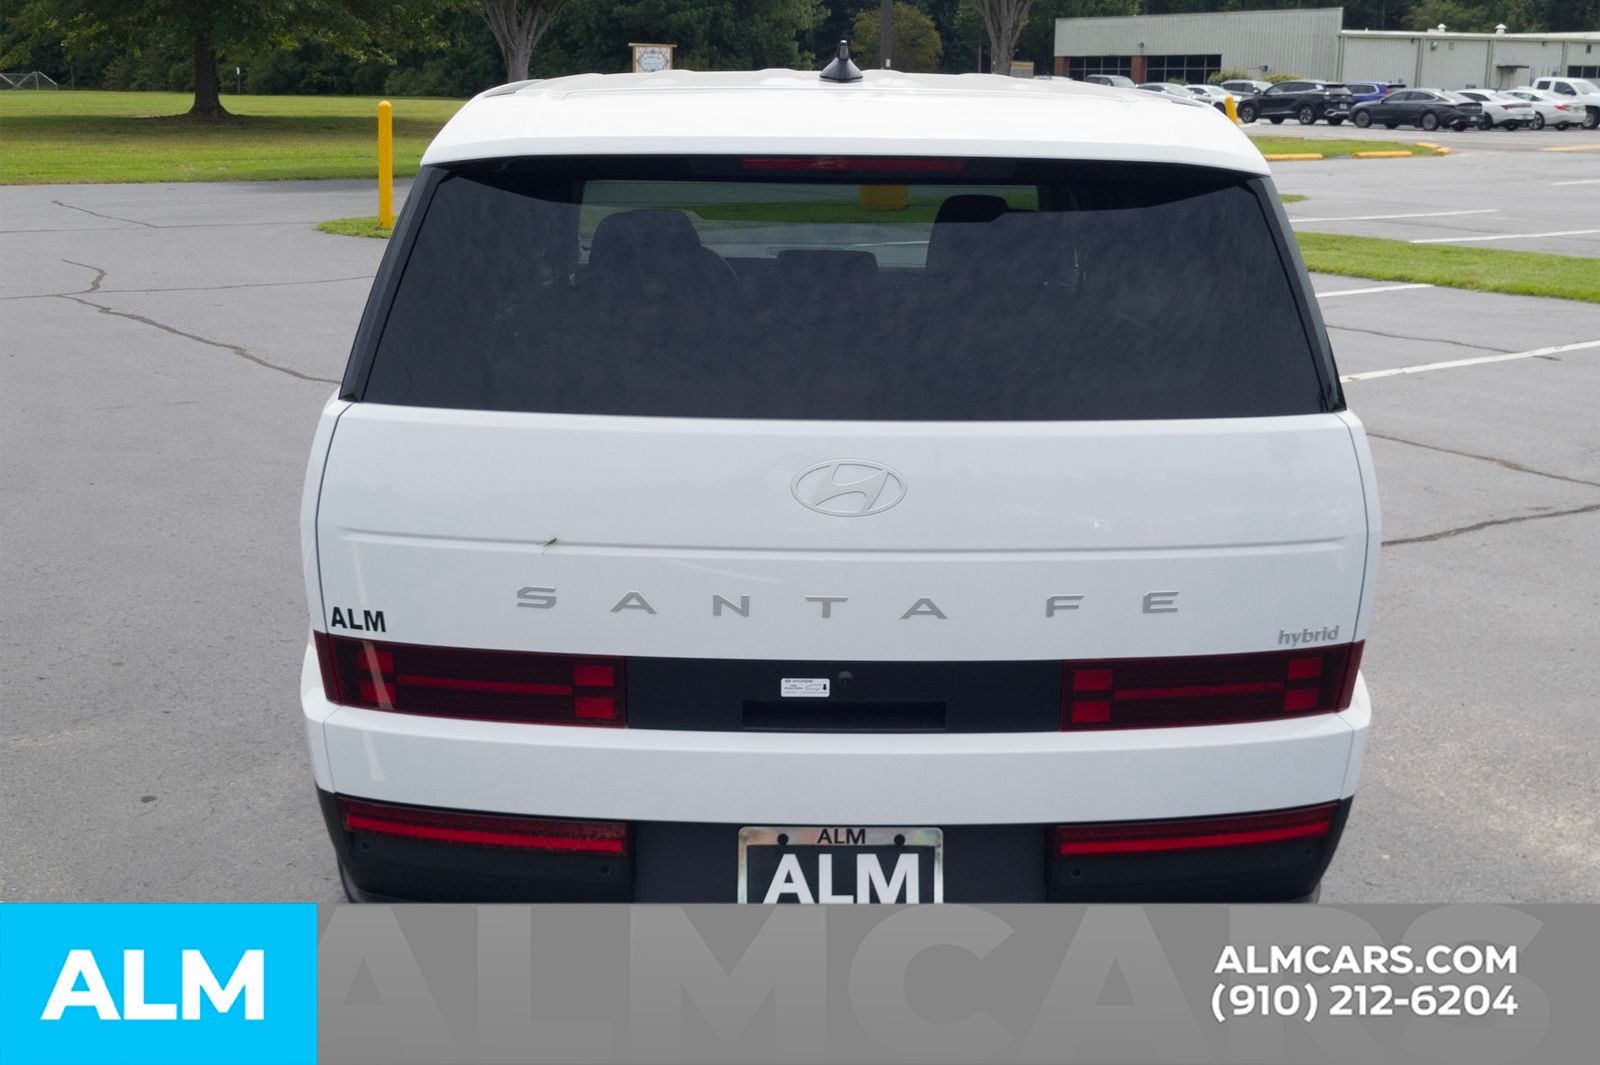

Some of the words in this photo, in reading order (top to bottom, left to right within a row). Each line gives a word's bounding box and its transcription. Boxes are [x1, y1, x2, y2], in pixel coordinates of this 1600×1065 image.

[516, 586, 948, 620] SANTA
[1046, 590, 1180, 618] FE
[330, 606, 387, 634] ALM
[1278, 625, 1340, 647] hybrid
[817, 828, 866, 845] ALM
[762, 853, 919, 904] ALM
